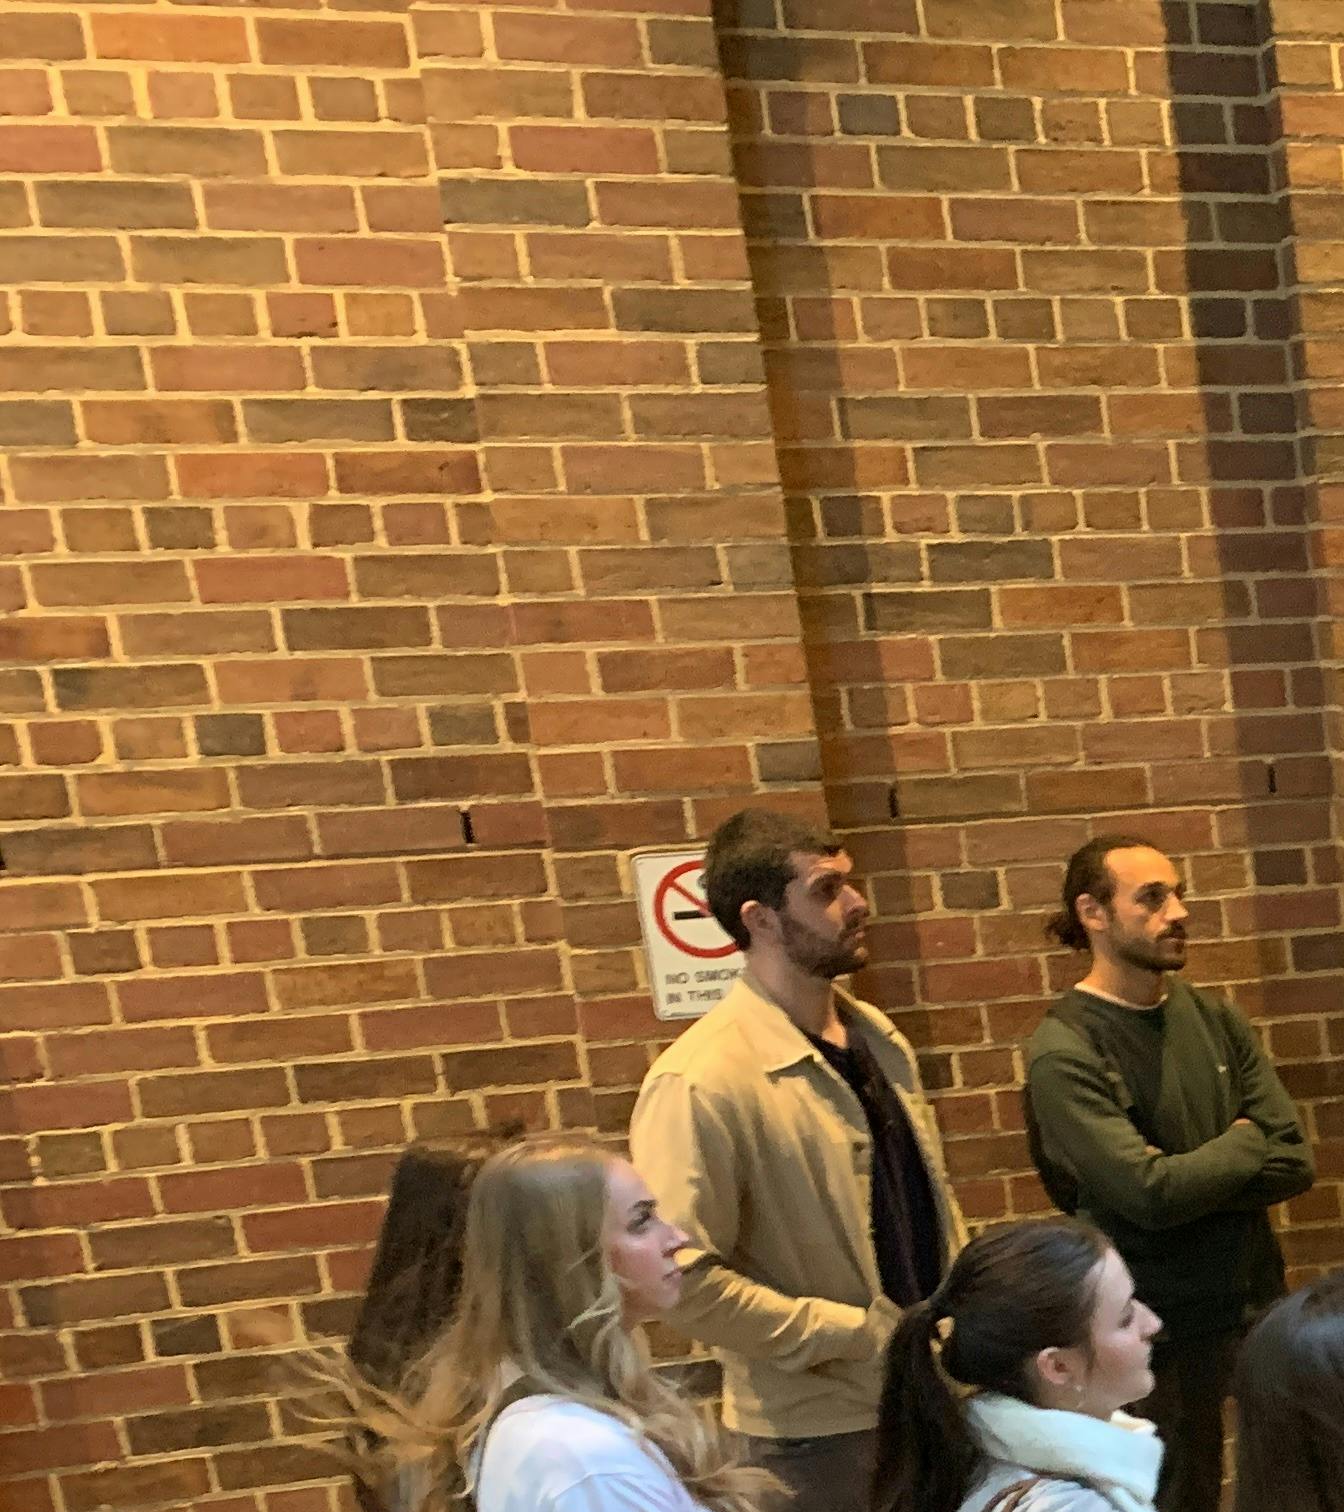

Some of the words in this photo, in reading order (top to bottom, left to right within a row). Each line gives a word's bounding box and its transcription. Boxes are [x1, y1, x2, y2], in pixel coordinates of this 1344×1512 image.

[666, 972, 689, 984] NO
[695, 968, 742, 983] SMOK
[688, 988, 722, 1001] THIS
